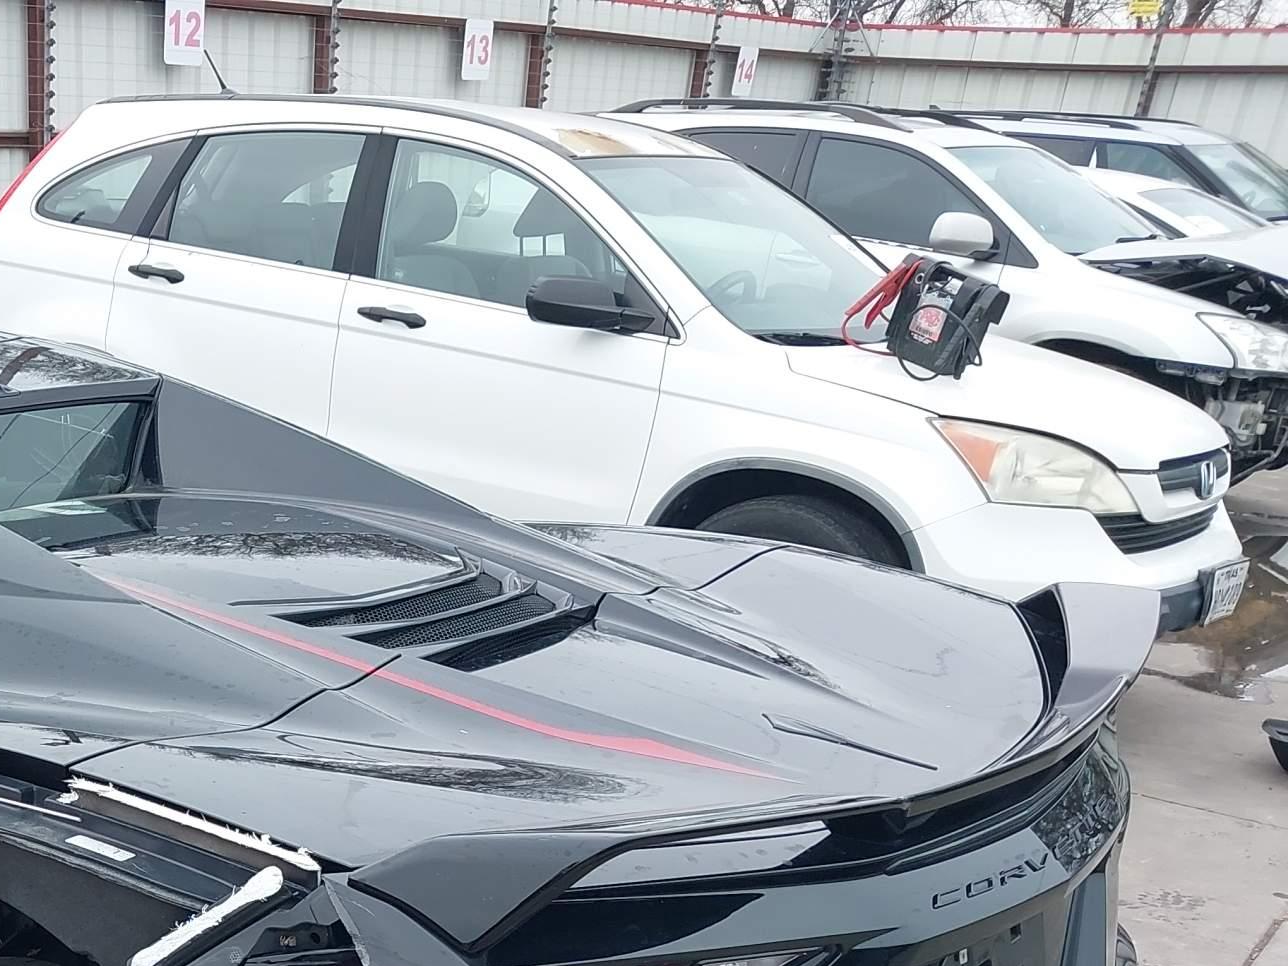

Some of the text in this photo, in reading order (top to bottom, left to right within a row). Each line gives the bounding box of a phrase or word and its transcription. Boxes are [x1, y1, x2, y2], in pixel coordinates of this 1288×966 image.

[169, 10, 201, 48] 12
[467, 34, 490, 66] 13
[738, 58, 755, 84] 14
